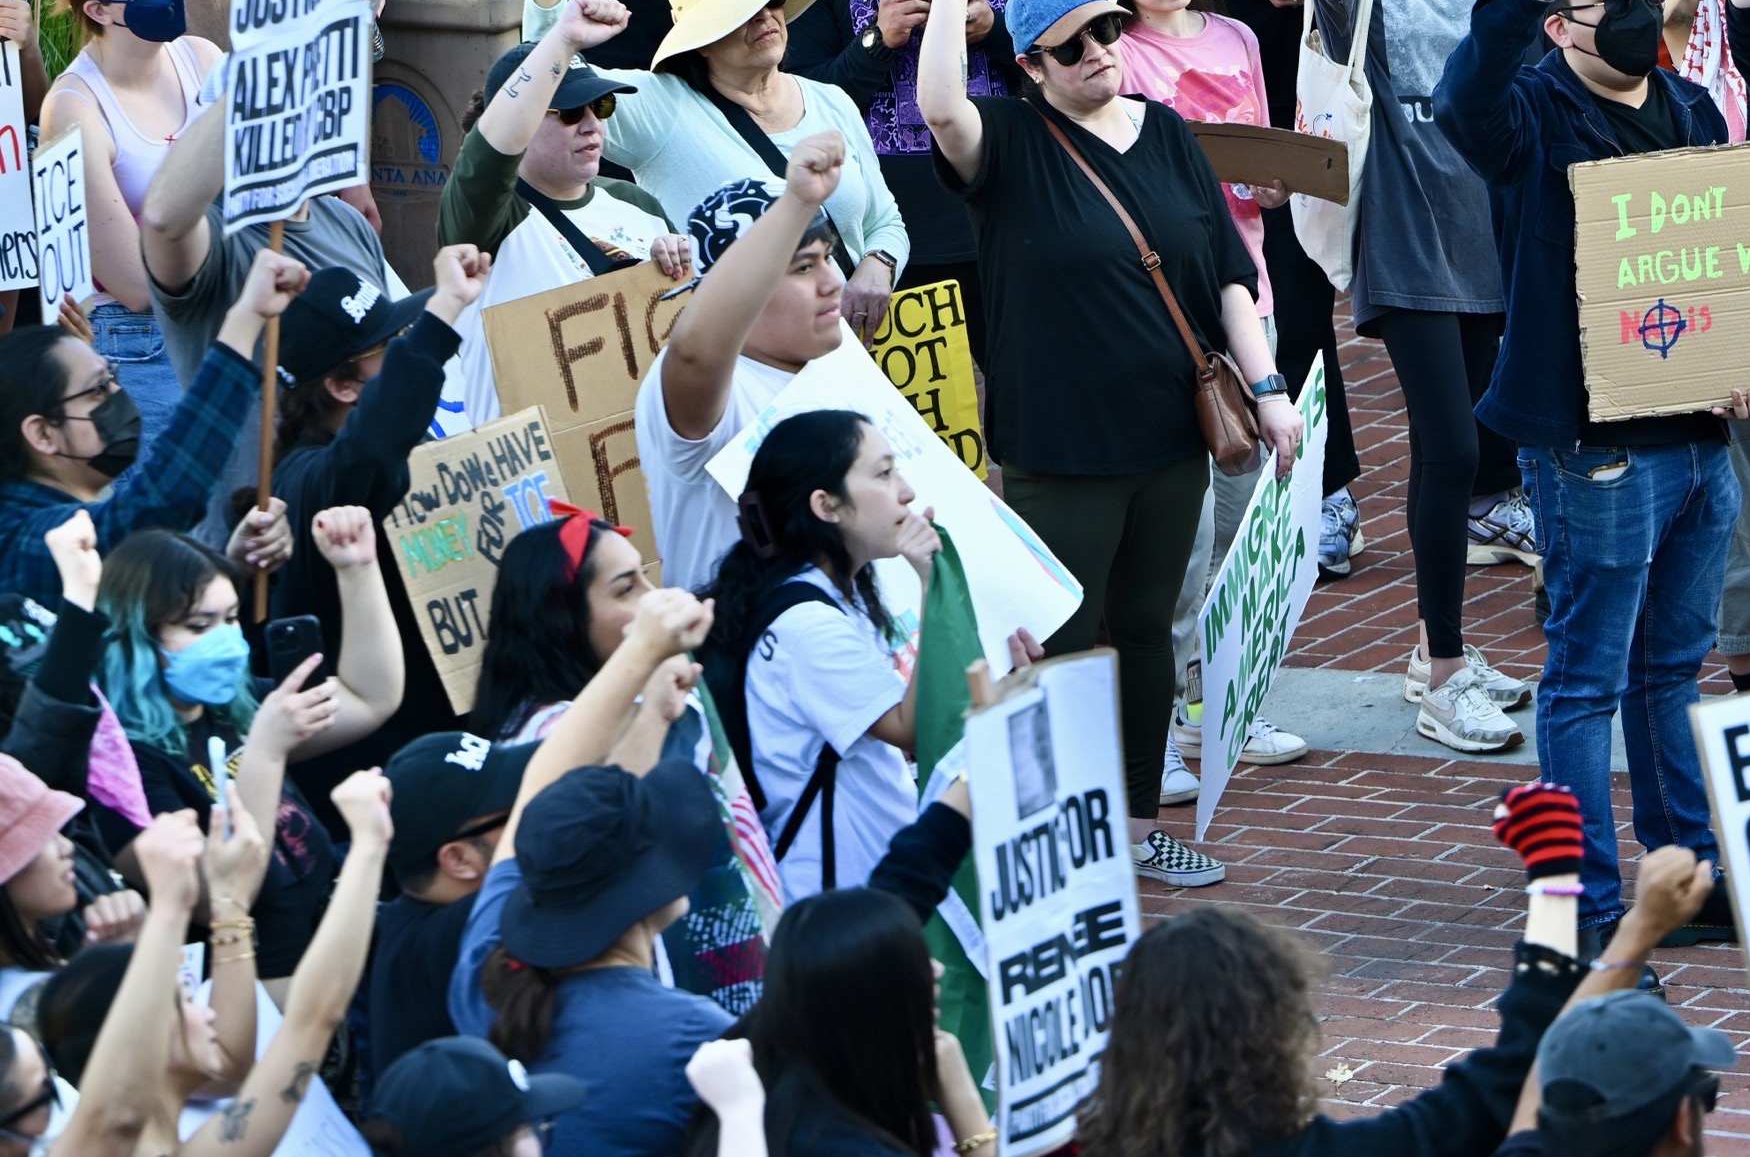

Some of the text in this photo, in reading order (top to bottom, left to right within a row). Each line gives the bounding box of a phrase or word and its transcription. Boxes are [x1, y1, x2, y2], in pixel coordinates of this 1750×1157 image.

[232, 47, 298, 125] ALEX
[37, 148, 81, 235] ICE
[371, 166, 447, 186] NTA ANA
[1611, 186, 1727, 241] I DON'T
[41, 220, 86, 305] OUT
[1617, 246, 1723, 289] ARGUE
[486, 420, 553, 482] HAVE
[397, 508, 476, 579] MONEY
[1205, 367, 1326, 665] IMMIGRATS
[1241, 490, 1293, 647] MAKE
[426, 588, 488, 656] BUT
[1219, 525, 1307, 742] AMERICA
[1227, 602, 1293, 771] GREAT
